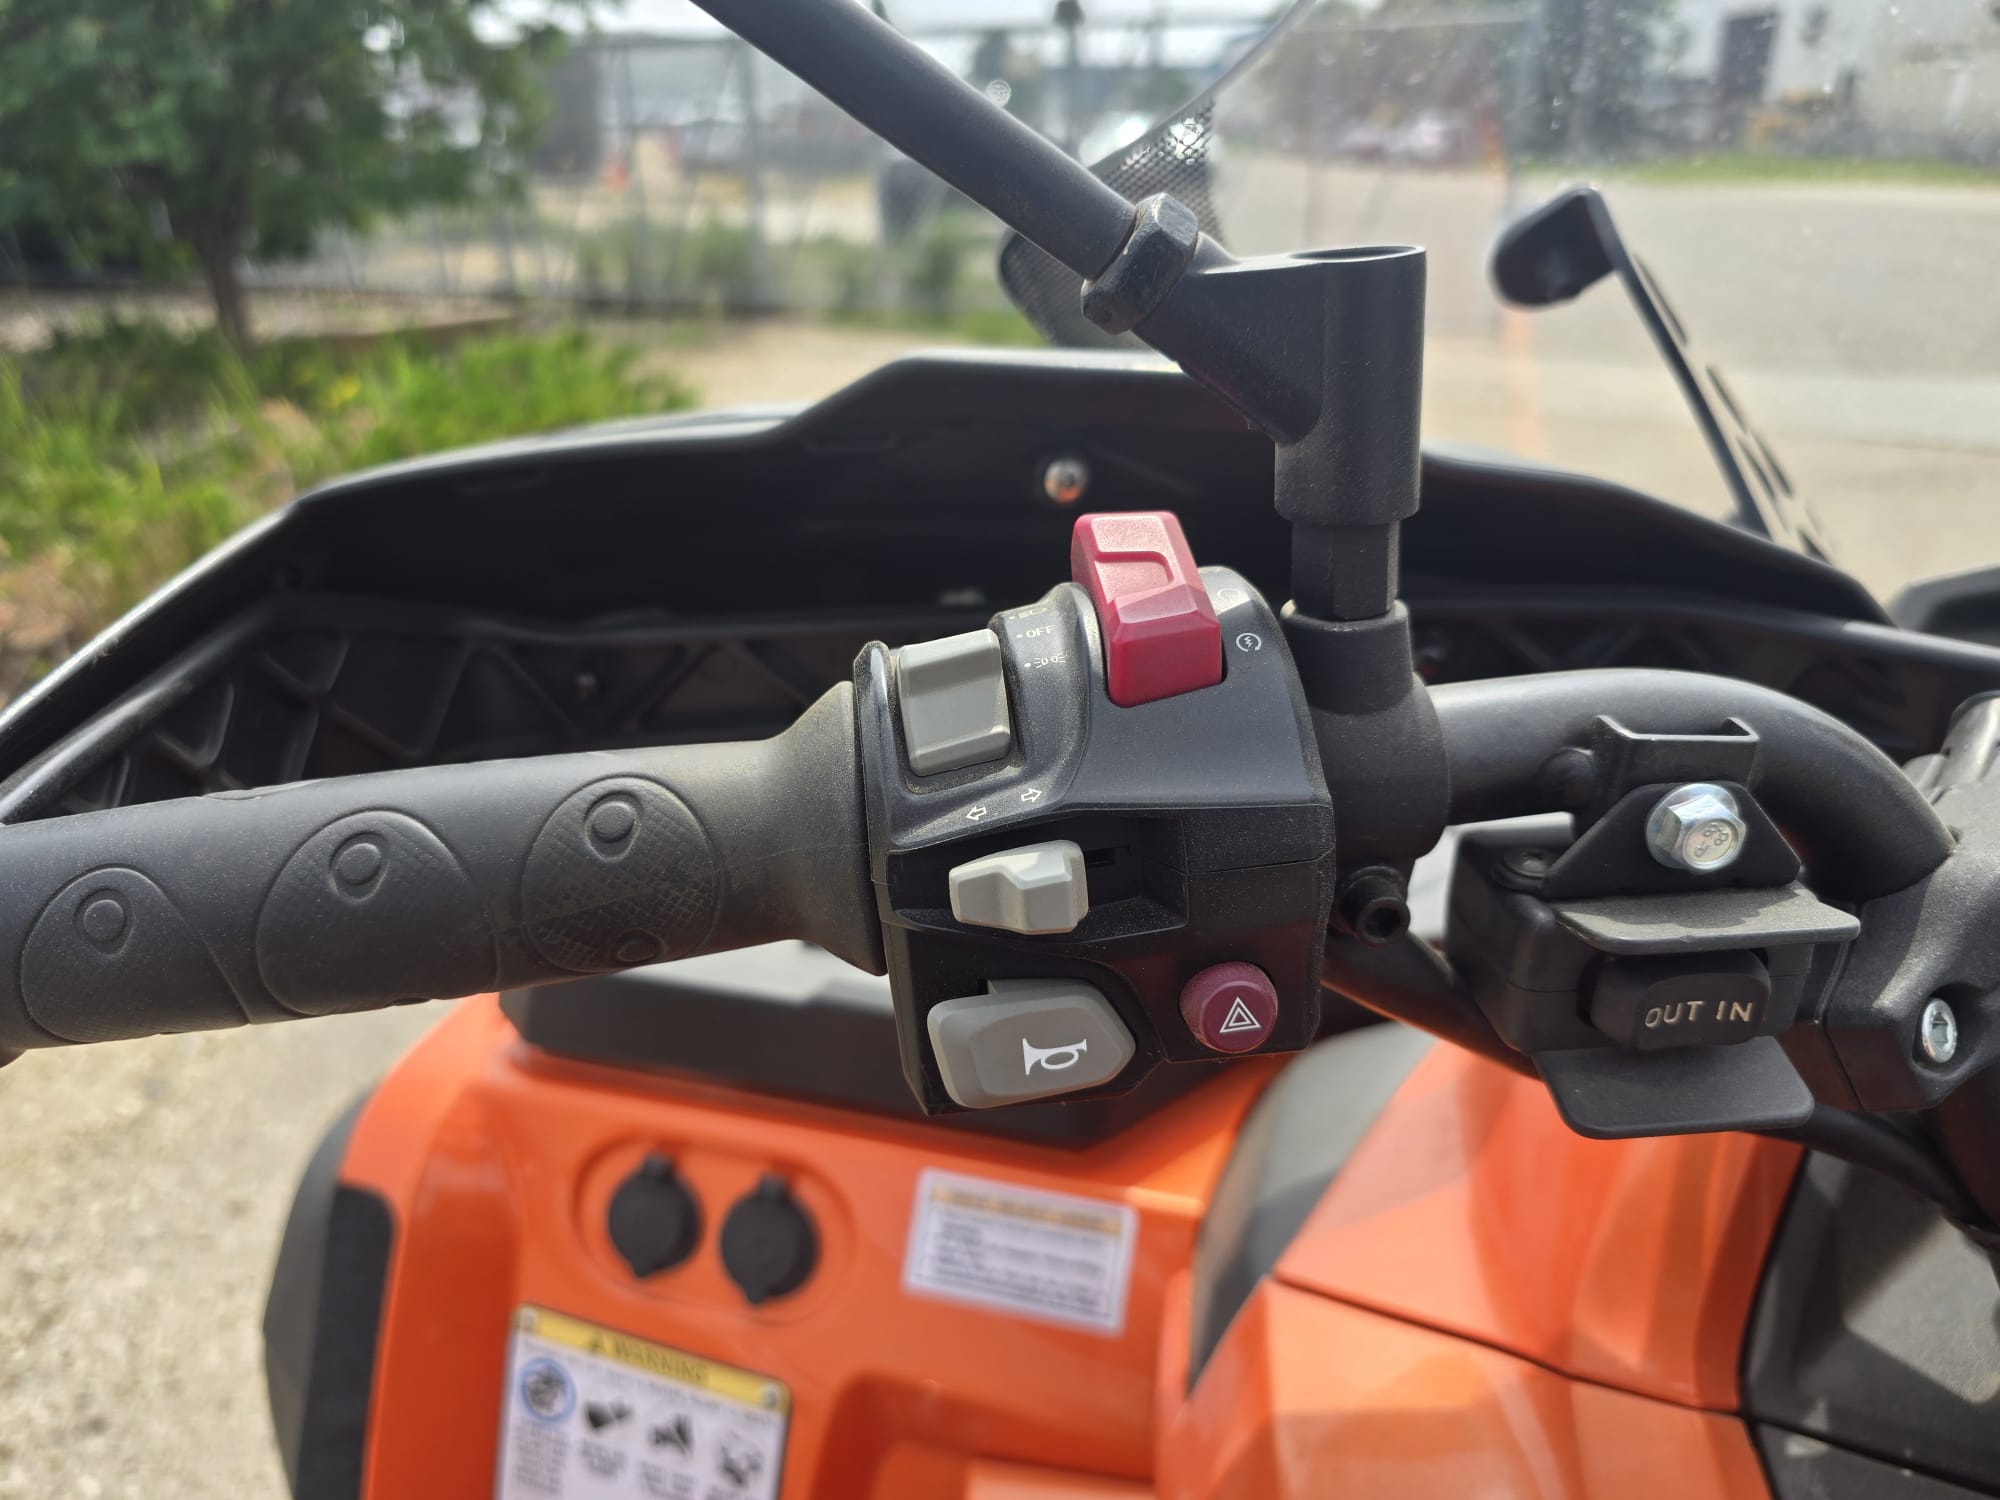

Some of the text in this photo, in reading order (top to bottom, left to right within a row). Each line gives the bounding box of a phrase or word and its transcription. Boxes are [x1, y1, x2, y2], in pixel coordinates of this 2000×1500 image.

[1026, 624, 1056, 638] OFF
[1645, 1000, 1753, 1028] OUT IN
[614, 1334, 705, 1381] WARNING
